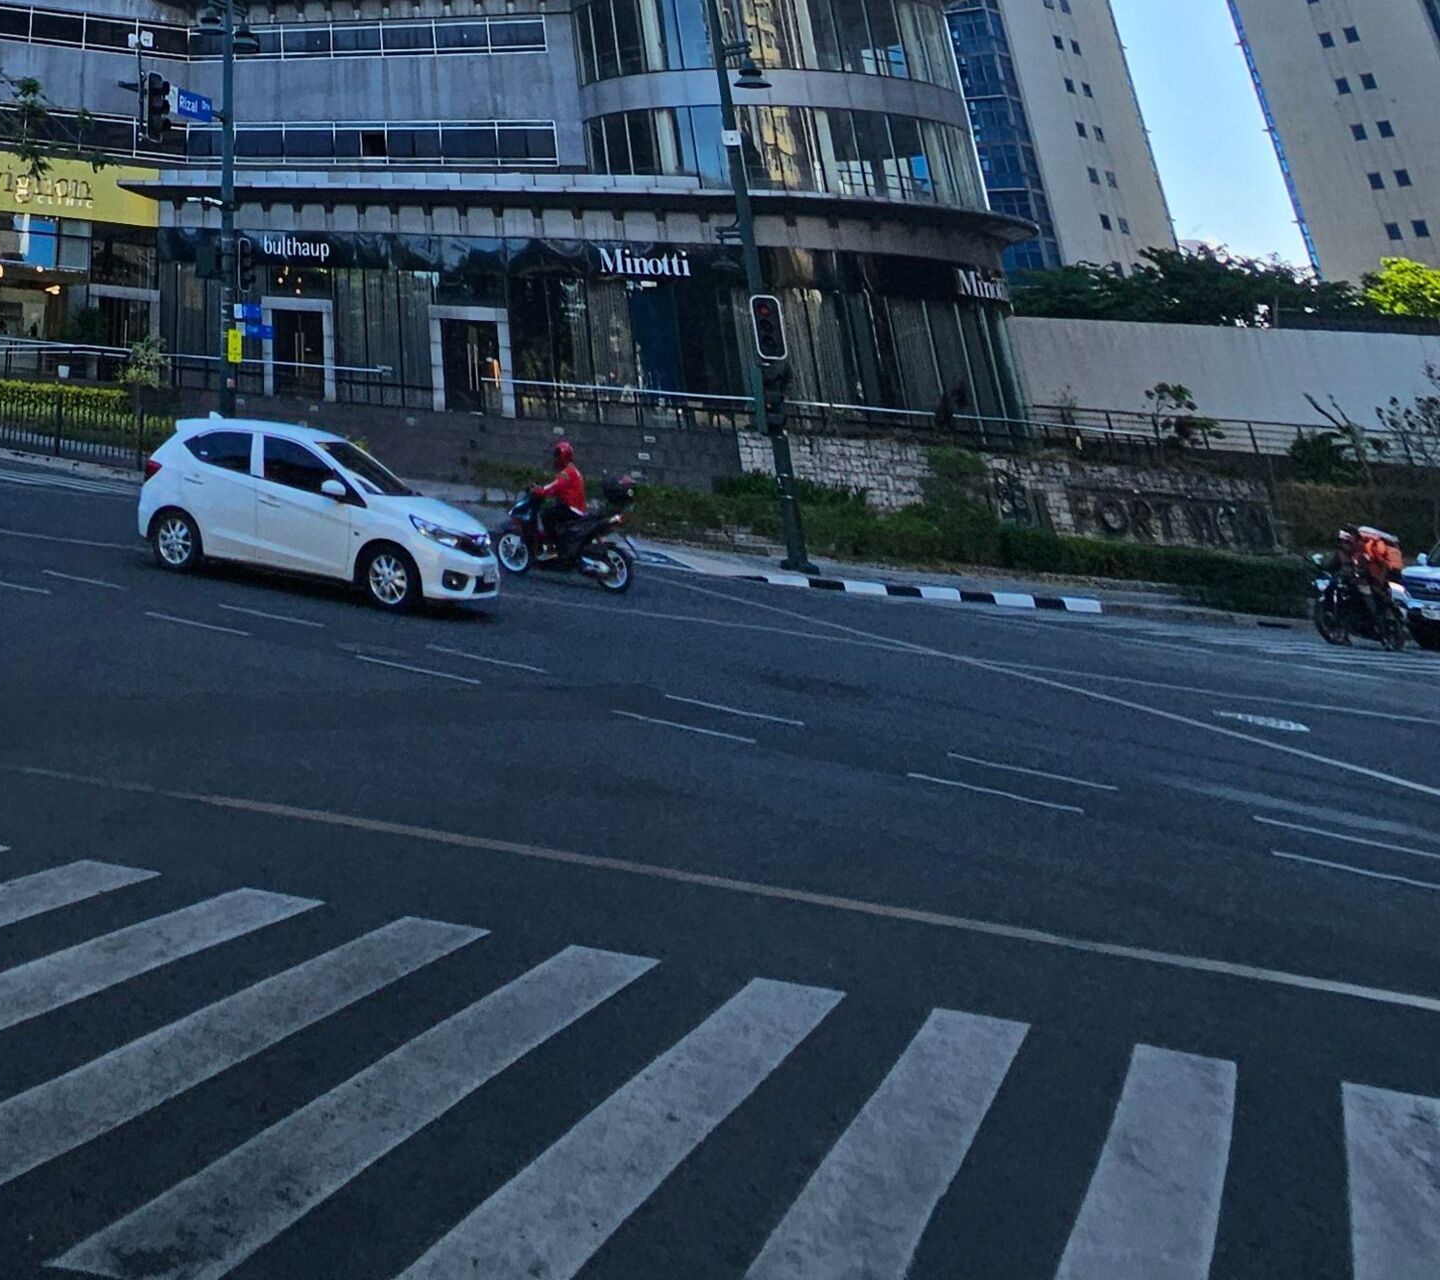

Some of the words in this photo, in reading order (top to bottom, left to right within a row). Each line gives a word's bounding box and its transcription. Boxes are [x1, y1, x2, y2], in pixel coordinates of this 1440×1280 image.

[179, 95, 198, 113] Rizal
[37, 195, 93, 209] CLINIC
[263, 235, 330, 262] bulthaup
[597, 247, 692, 277] Minotti
